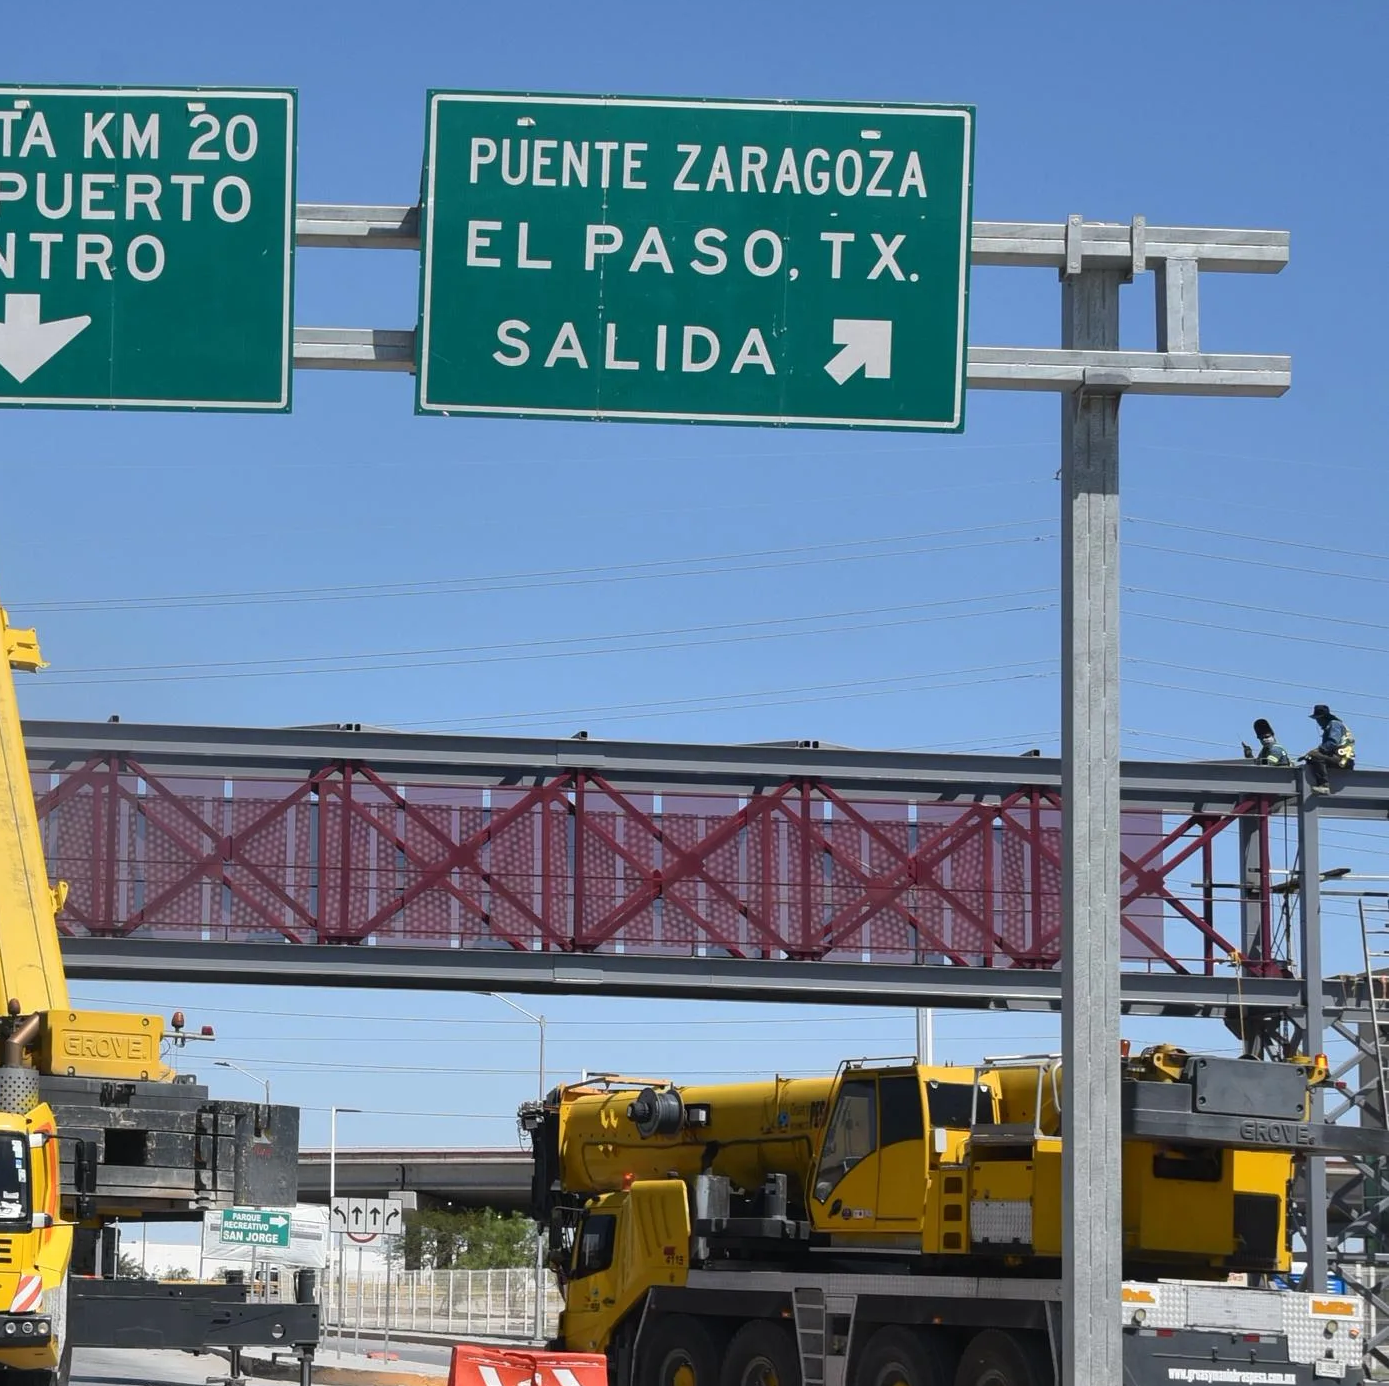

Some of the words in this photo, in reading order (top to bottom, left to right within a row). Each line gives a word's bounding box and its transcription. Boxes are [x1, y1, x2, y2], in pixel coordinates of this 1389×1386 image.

[83, 112, 160, 160] KM
[188, 114, 259, 162] 20
[469, 137, 648, 190] PUENTE
[673, 144, 927, 198] ZARAGOZA
[466, 220, 552, 269] EL
[584, 224, 799, 282] PASO,
[820, 232, 920, 282] TX.
[492, 319, 776, 375] SALIDA
[223, 1231, 243, 1241] SAN
[246, 1232, 279, 1243] JORGE
[225, 1221, 269, 1231] RECREATIVO
[233, 1213, 262, 1221] PARQUE
